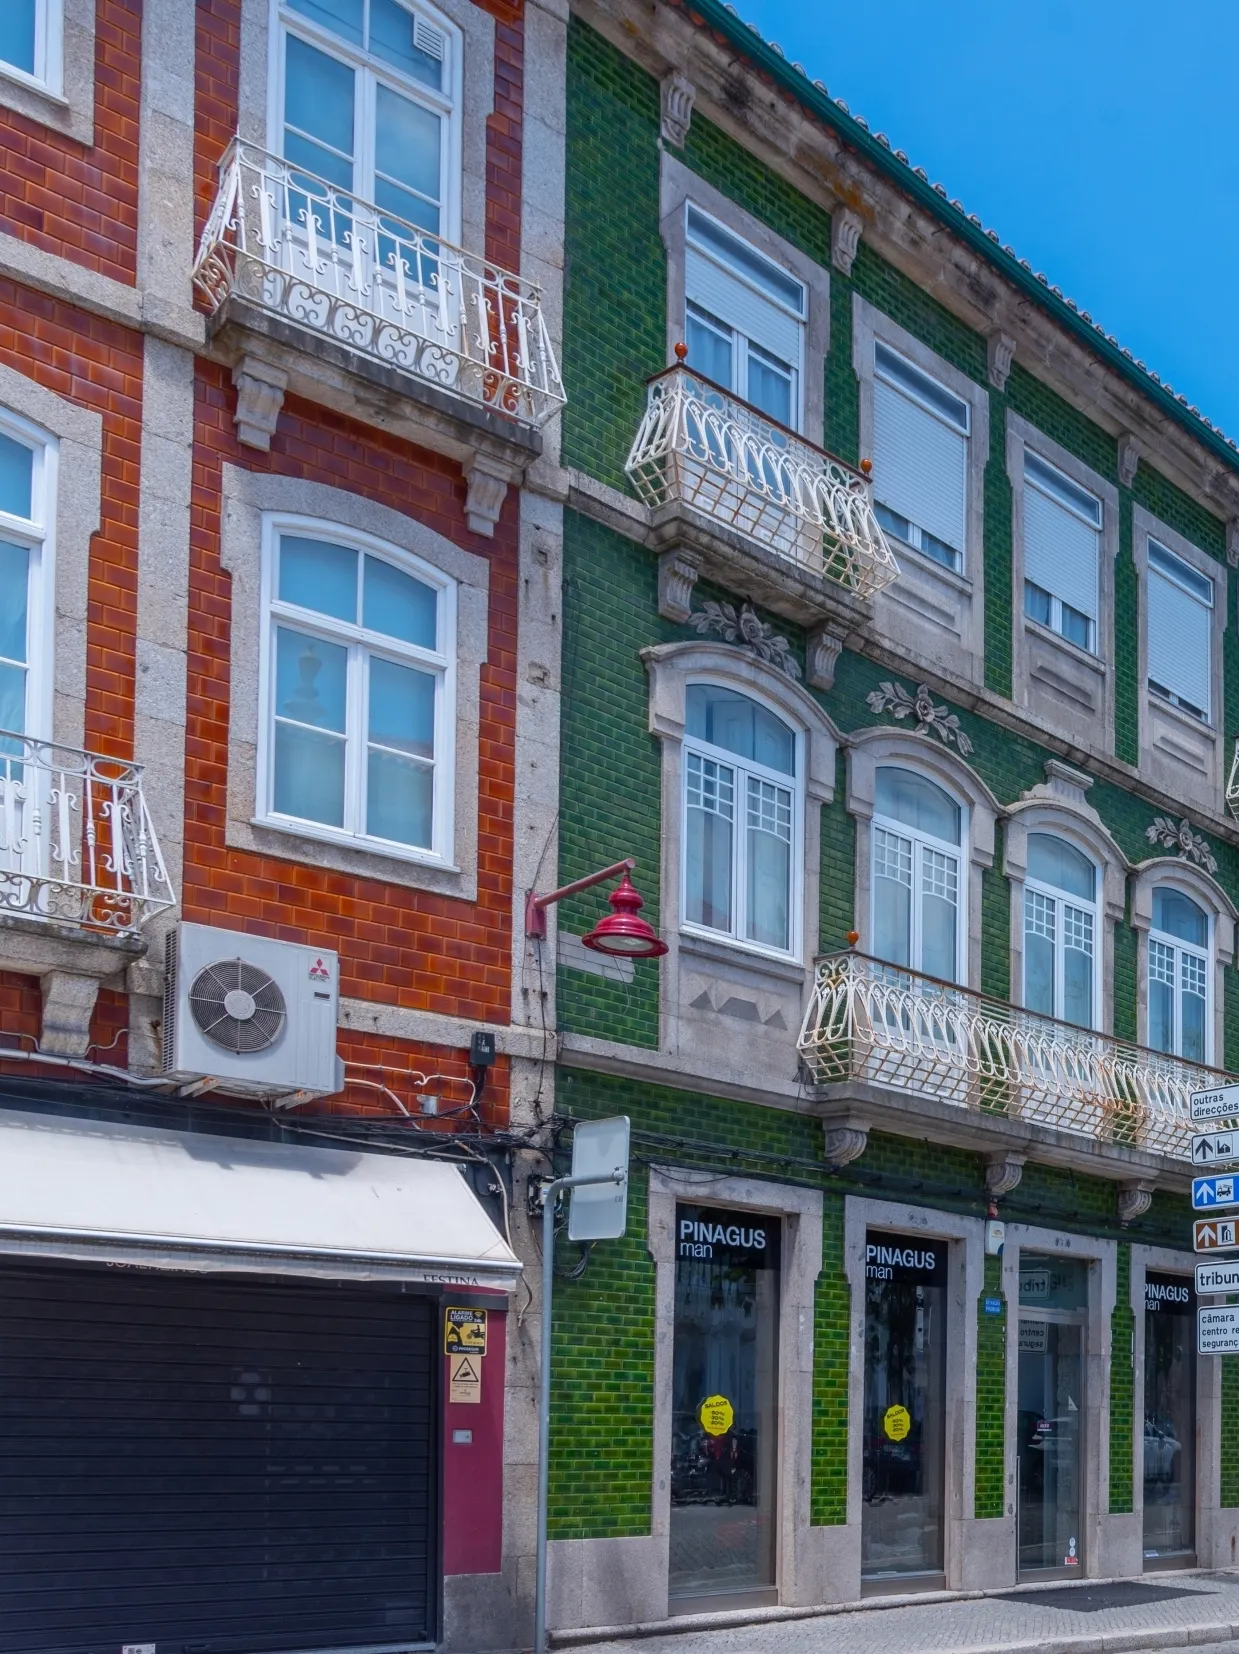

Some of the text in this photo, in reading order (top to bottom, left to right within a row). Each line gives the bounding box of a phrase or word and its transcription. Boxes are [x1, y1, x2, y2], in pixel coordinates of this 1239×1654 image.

[1193, 1093, 1224, 1106] outras
[1193, 1102, 1239, 1117] direcções
[680, 1219, 766, 1250] PINAGUS
[680, 1242, 713, 1258] man
[866, 1244, 936, 1270] PINAGUS
[866, 1265, 893, 1280] man
[1201, 1313, 1235, 1324] câmara
[1201, 1326, 1228, 1336] centro
[704, 1400, 728, 1409] SALDOS
